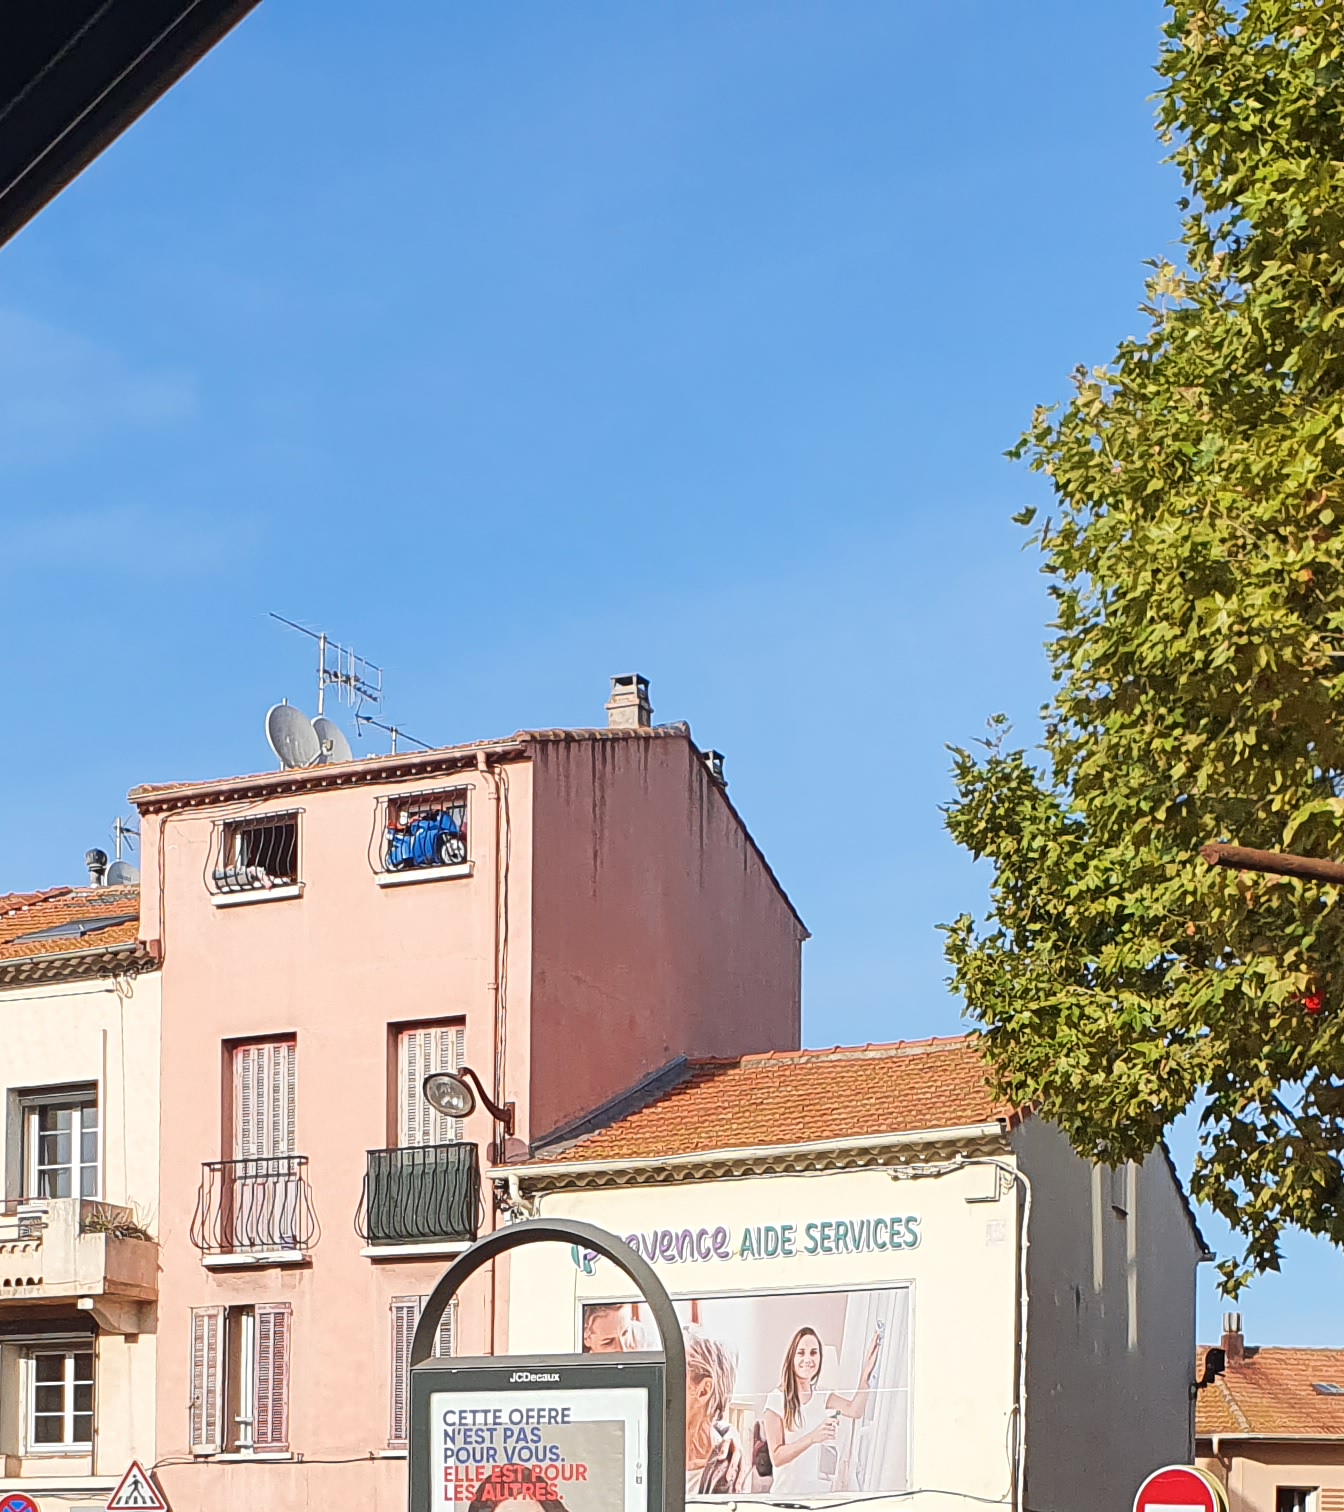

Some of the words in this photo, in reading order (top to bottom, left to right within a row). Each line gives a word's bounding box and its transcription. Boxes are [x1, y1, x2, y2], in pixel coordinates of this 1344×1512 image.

[739, 1224, 795, 1259] AIDE
[804, 1216, 920, 1255] SERVICES
[509, 1372, 560, 1383] JCDecaux
[443, 1408, 503, 1427] CETTE
[508, 1407, 572, 1426] OFFRE
[443, 1427, 498, 1446] N'EST
[503, 1427, 542, 1445] PAS
[443, 1446, 498, 1464] POUR
[503, 1445, 566, 1463] VOUS.
[444, 1465, 485, 1483] ELLE
[491, 1464, 526, 1482] EST
[531, 1463, 588, 1481] POUR
[444, 1484, 478, 1501] LES
[482, 1483, 564, 1501] AUTRES.
